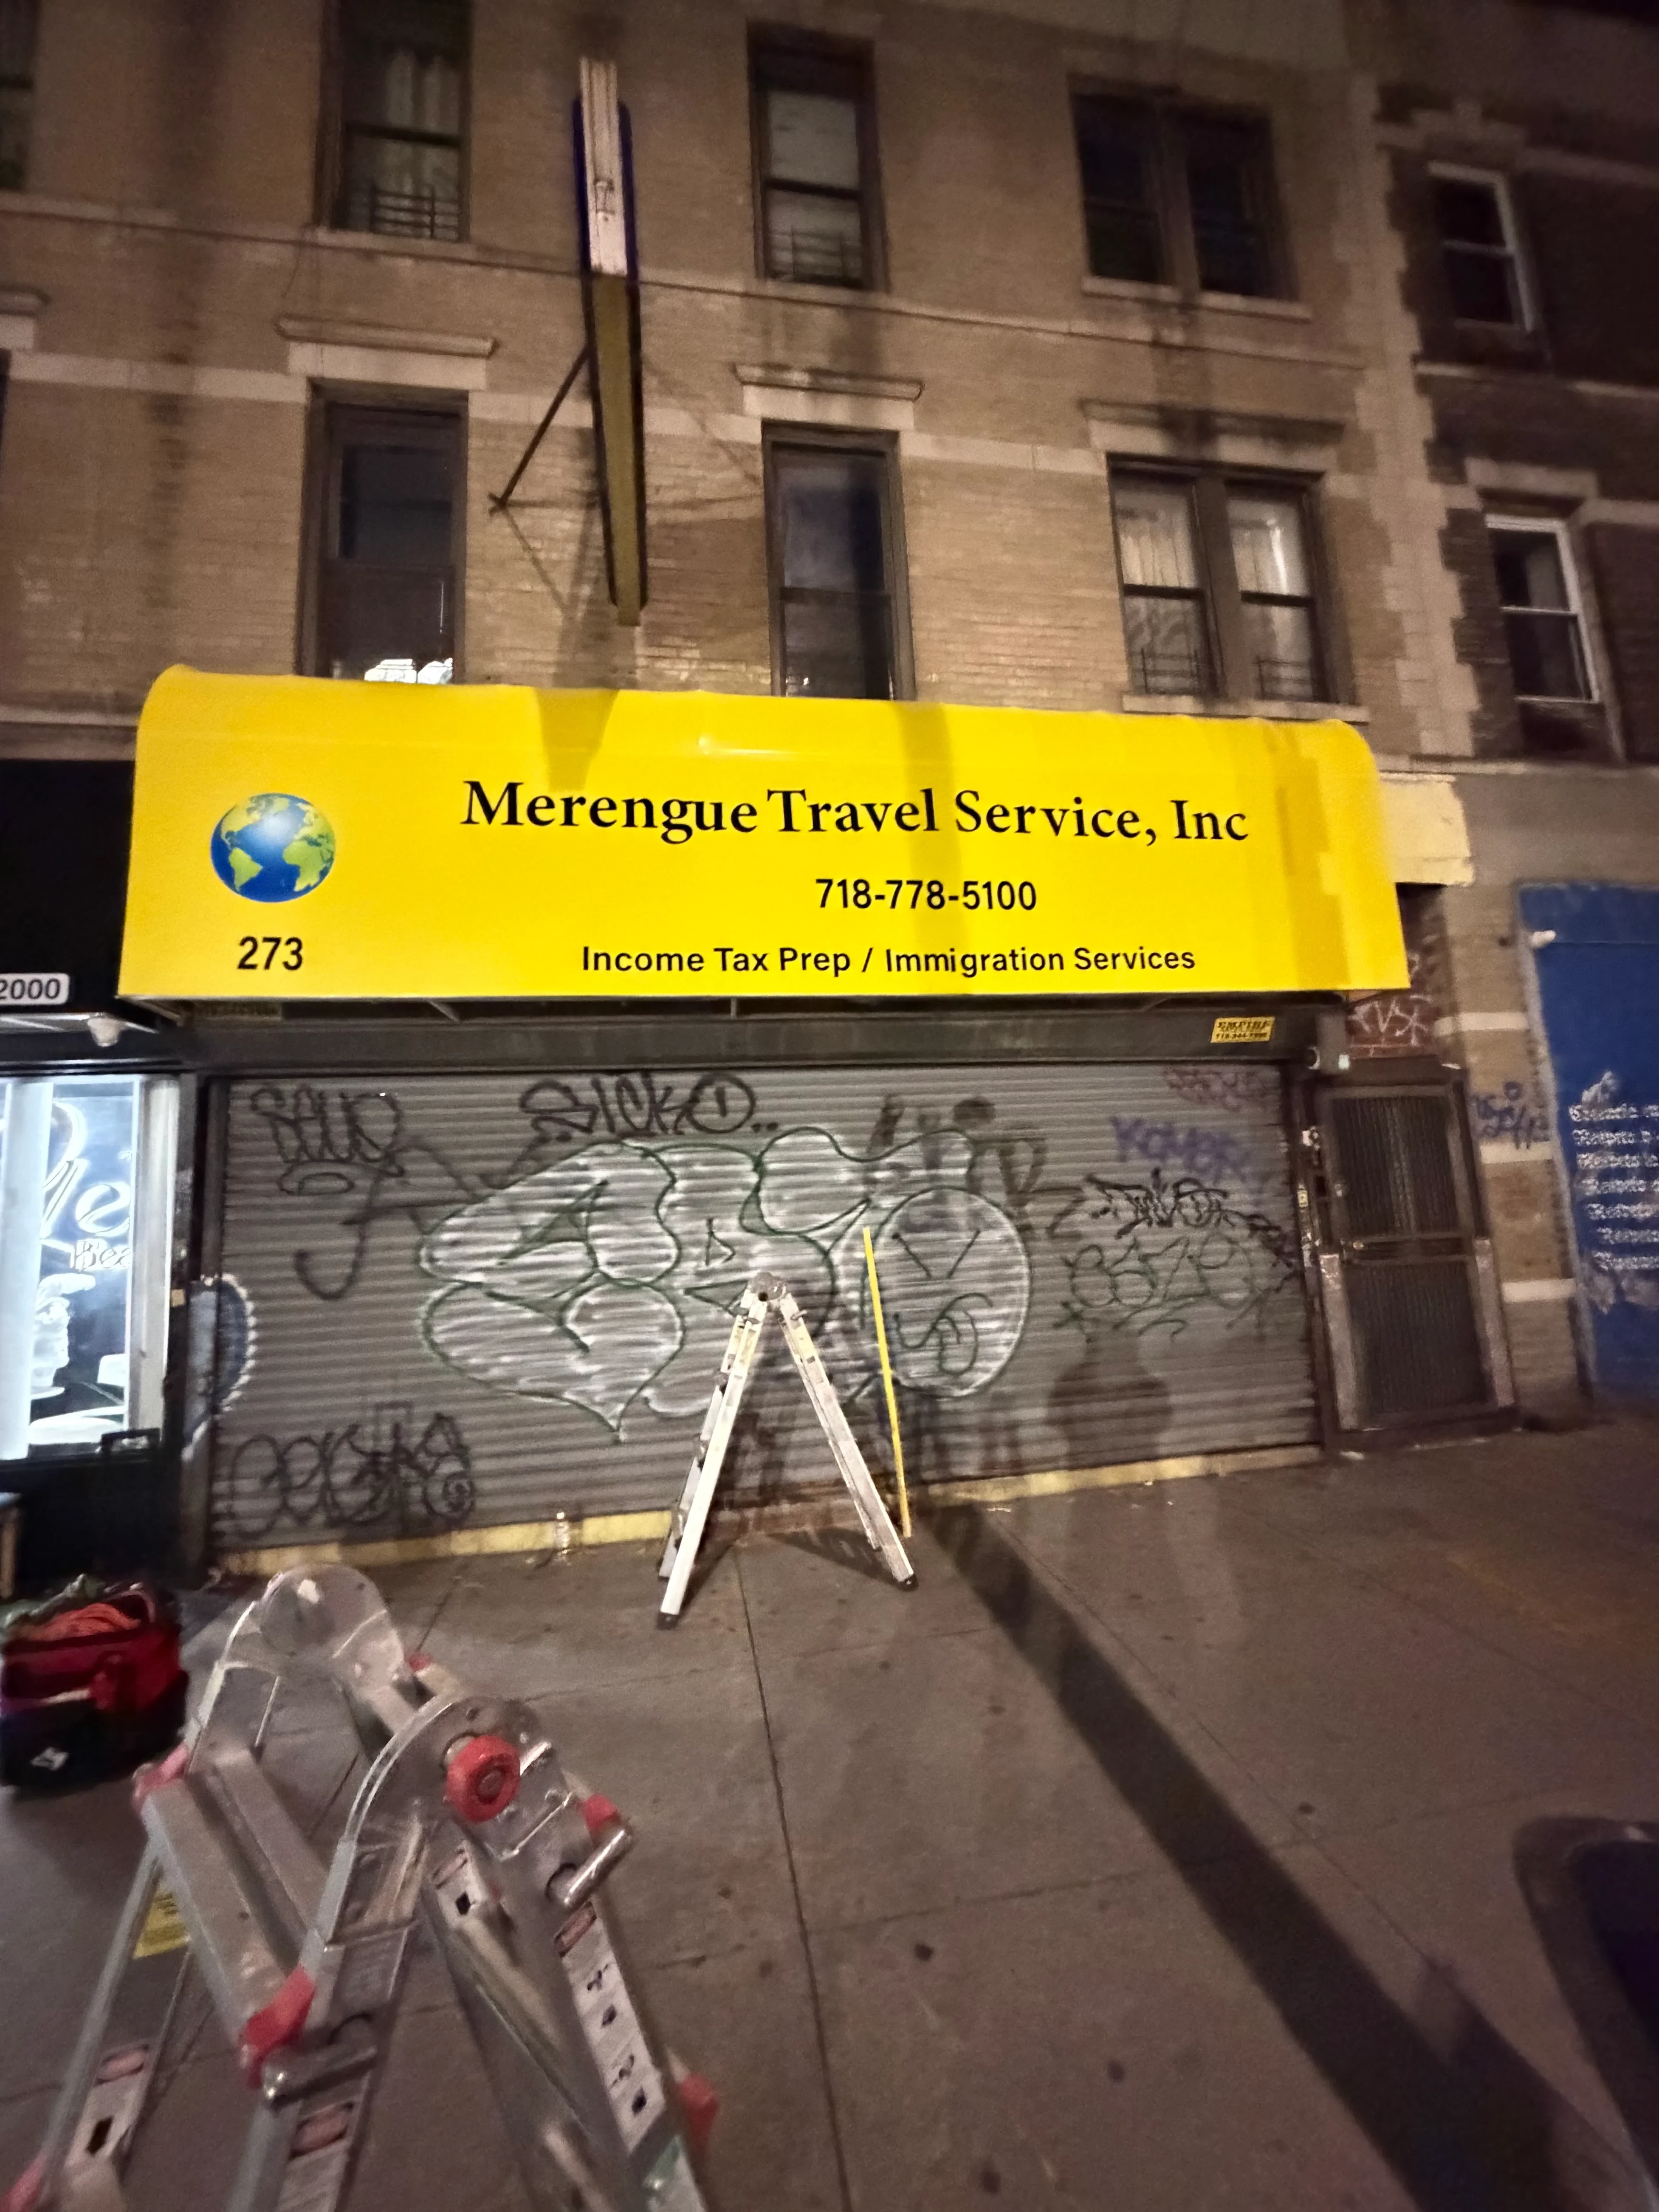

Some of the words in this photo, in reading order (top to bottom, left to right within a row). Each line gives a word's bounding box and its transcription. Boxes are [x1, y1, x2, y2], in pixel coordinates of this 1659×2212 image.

[461, 780, 758, 845] Merengue
[766, 787, 939, 833] Travel
[955, 789, 1157, 847] Service,
[1170, 799, 1249, 841] Inc
[815, 878, 1037, 911] 718-778-5100
[237, 936, 303, 971] 273
[582, 946, 705, 972] Income
[713, 947, 769, 972] Tax
[779, 946, 851, 978] Prep
[862, 947, 873, 973] /
[886, 946, 1065, 978] Immigration
[1074, 946, 1195, 970] Services
